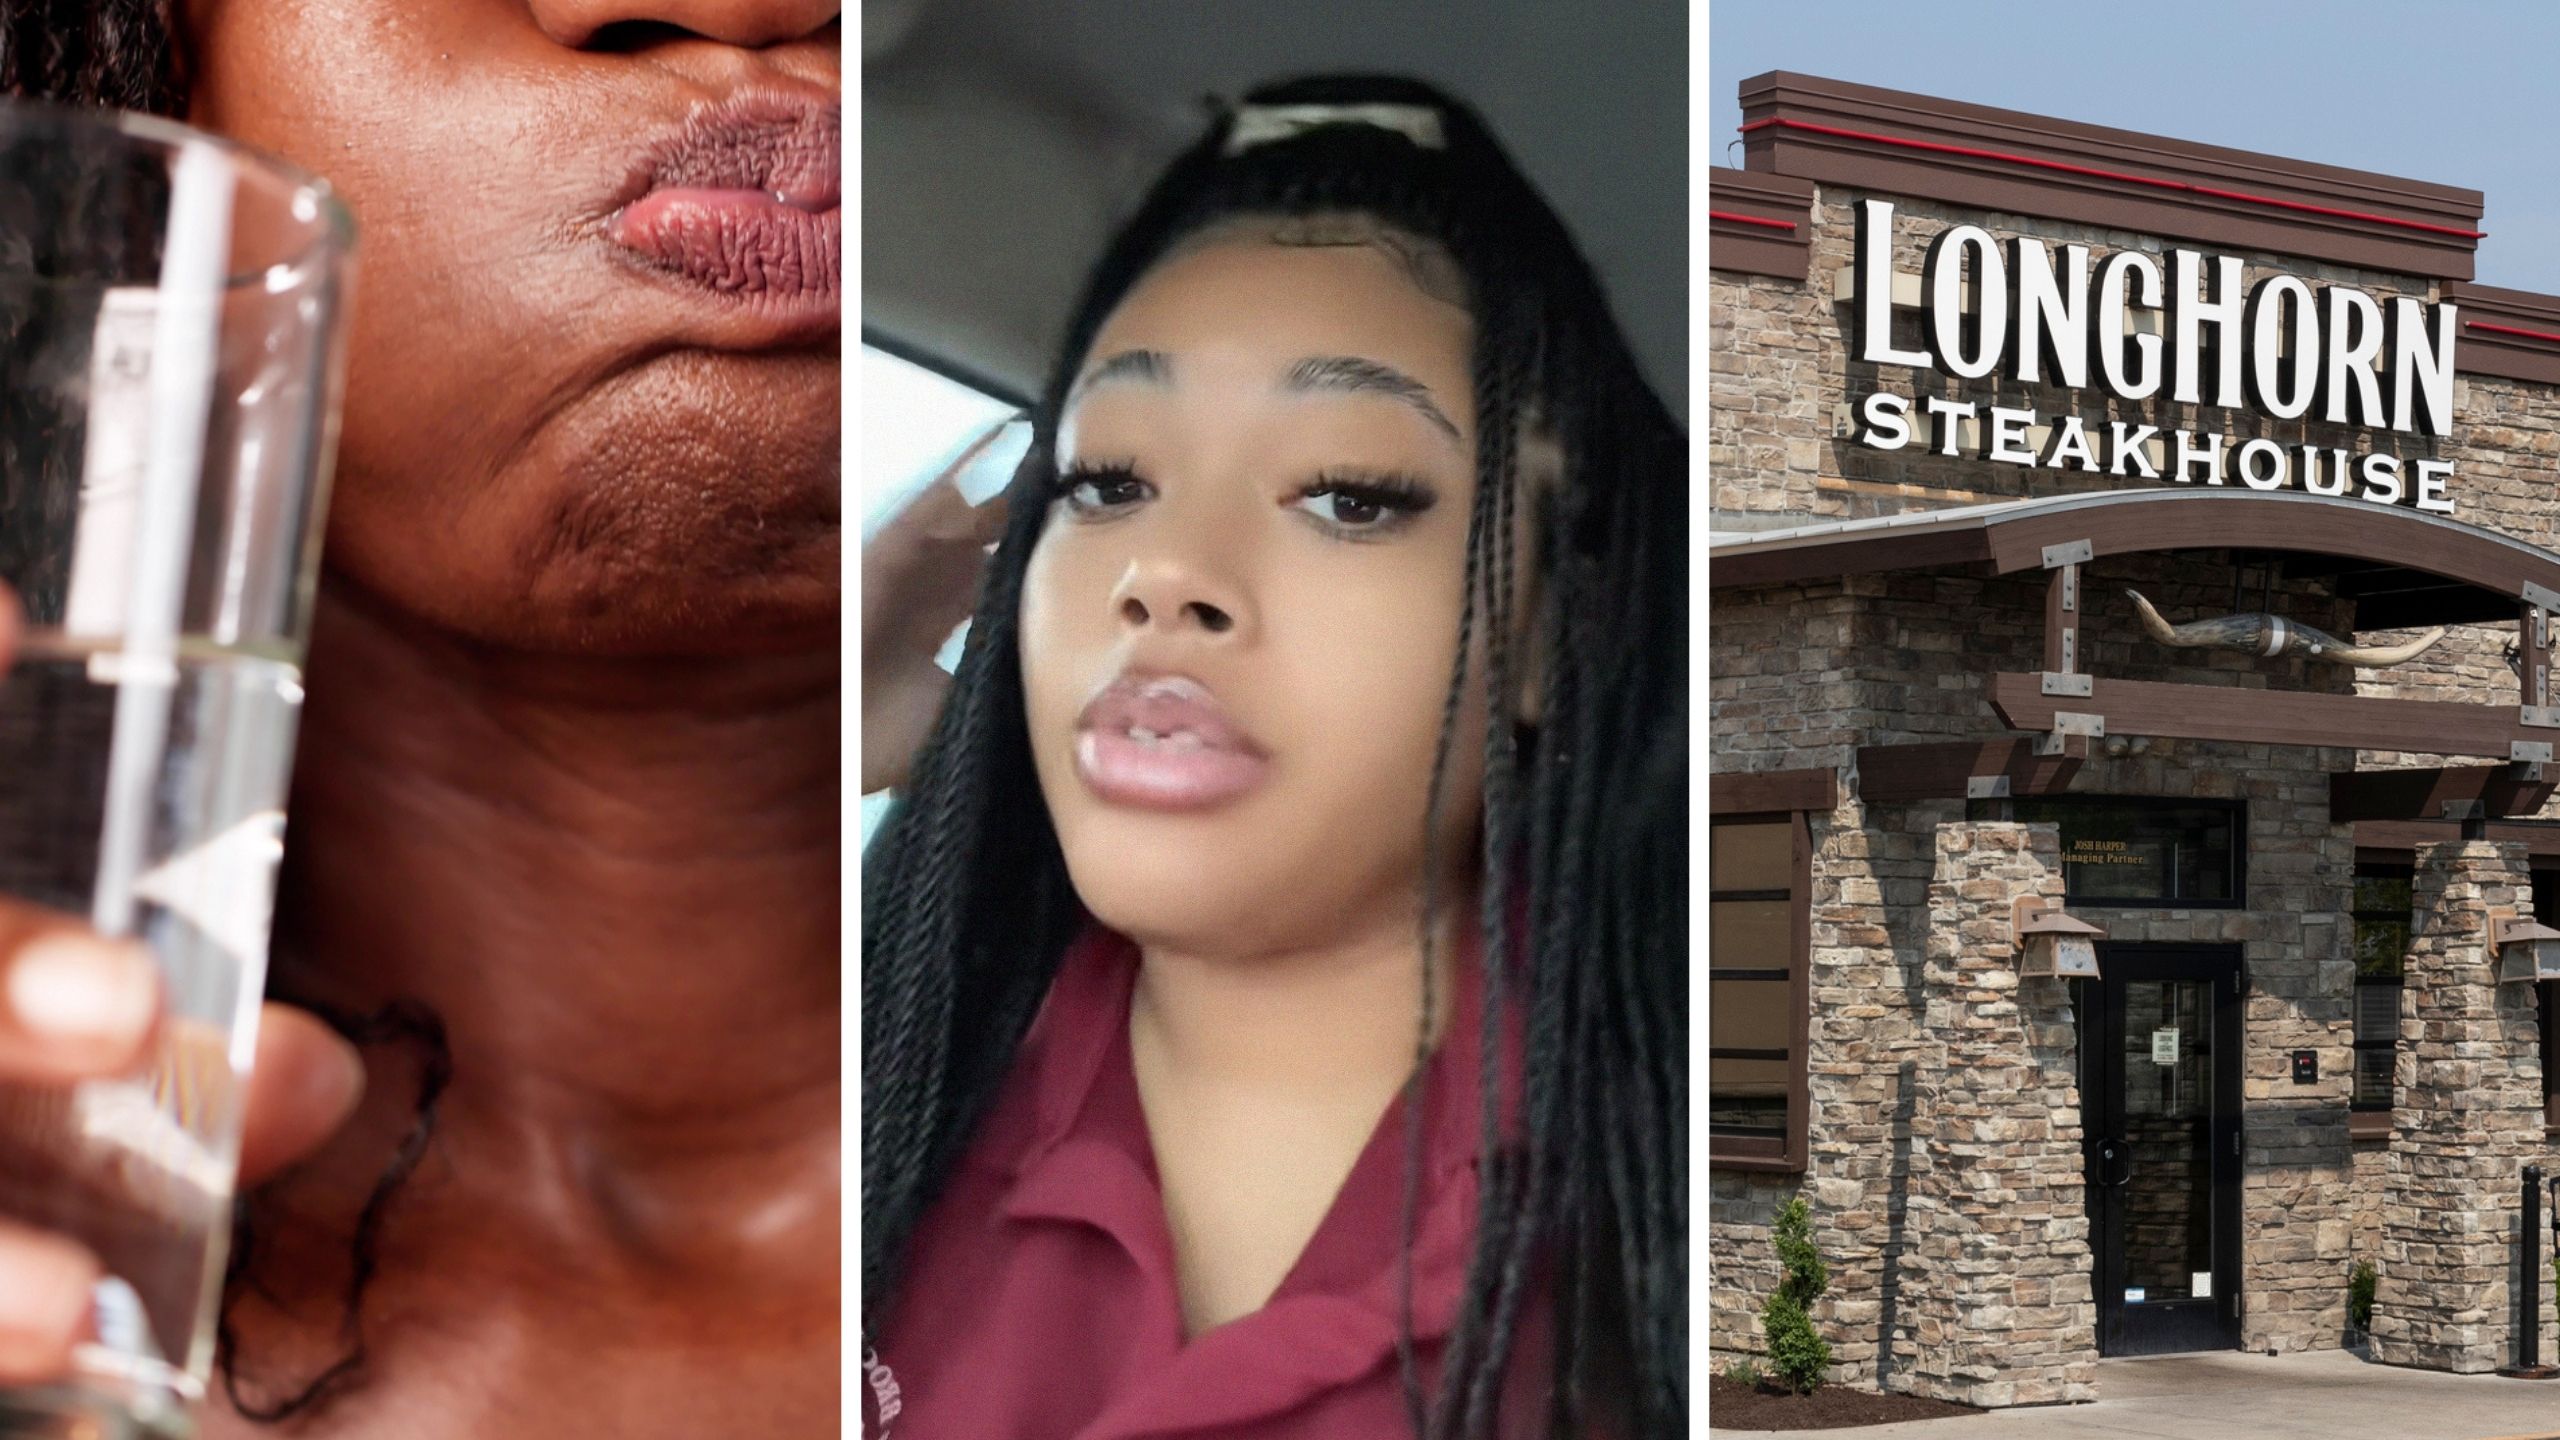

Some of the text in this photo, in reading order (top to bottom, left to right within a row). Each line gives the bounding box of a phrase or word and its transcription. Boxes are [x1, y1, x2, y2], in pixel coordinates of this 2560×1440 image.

[1861, 199, 2458, 437] LONGHORN
[1862, 391, 2456, 515] STEAKHOUSE
[2074, 840, 2127, 851] JOSH HARPER
[2107, 853, 2144, 864] Partner
